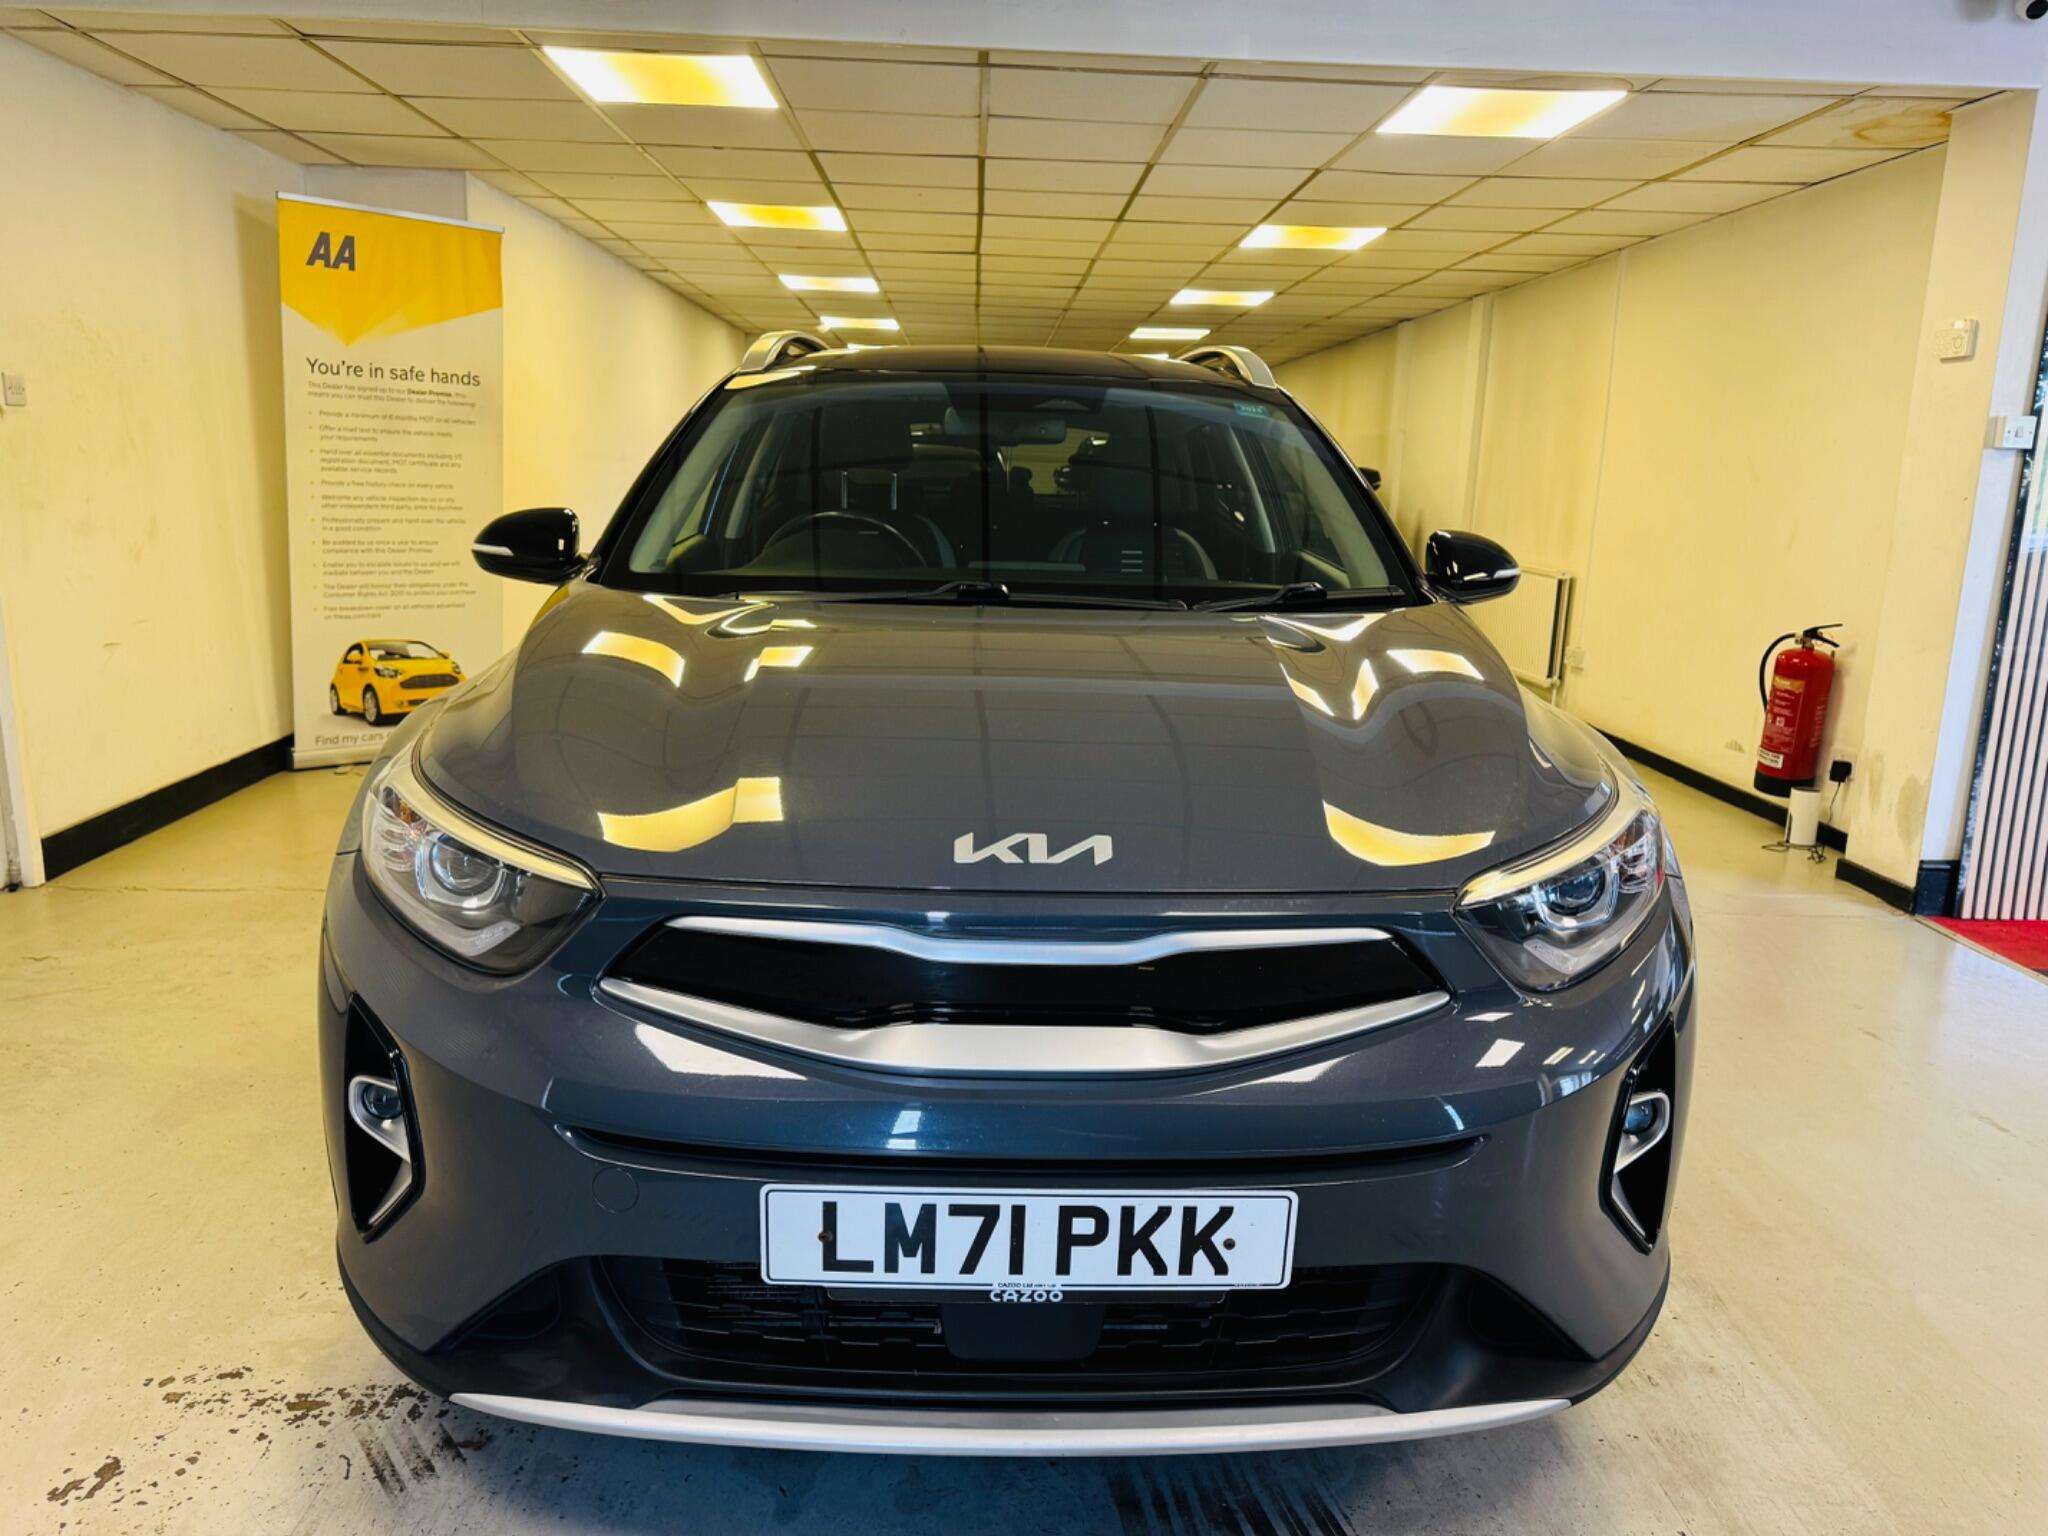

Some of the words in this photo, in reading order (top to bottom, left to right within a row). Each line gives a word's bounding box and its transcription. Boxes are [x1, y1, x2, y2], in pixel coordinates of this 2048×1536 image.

[305, 231, 355, 272] AA
[306, 357, 363, 377] You're
[369, 362, 384, 379] in
[390, 364, 425, 382] safe
[431, 368, 481, 387] hands
[315, 734, 339, 746] Find
[342, 734, 359, 745] my
[361, 732, 384, 743] cars
[953, 831, 1113, 866] KIA
[820, 1200, 1027, 1276] LM71
[1055, 1204, 1236, 1277] PKK
[990, 1289, 1063, 1303] CAZOO
